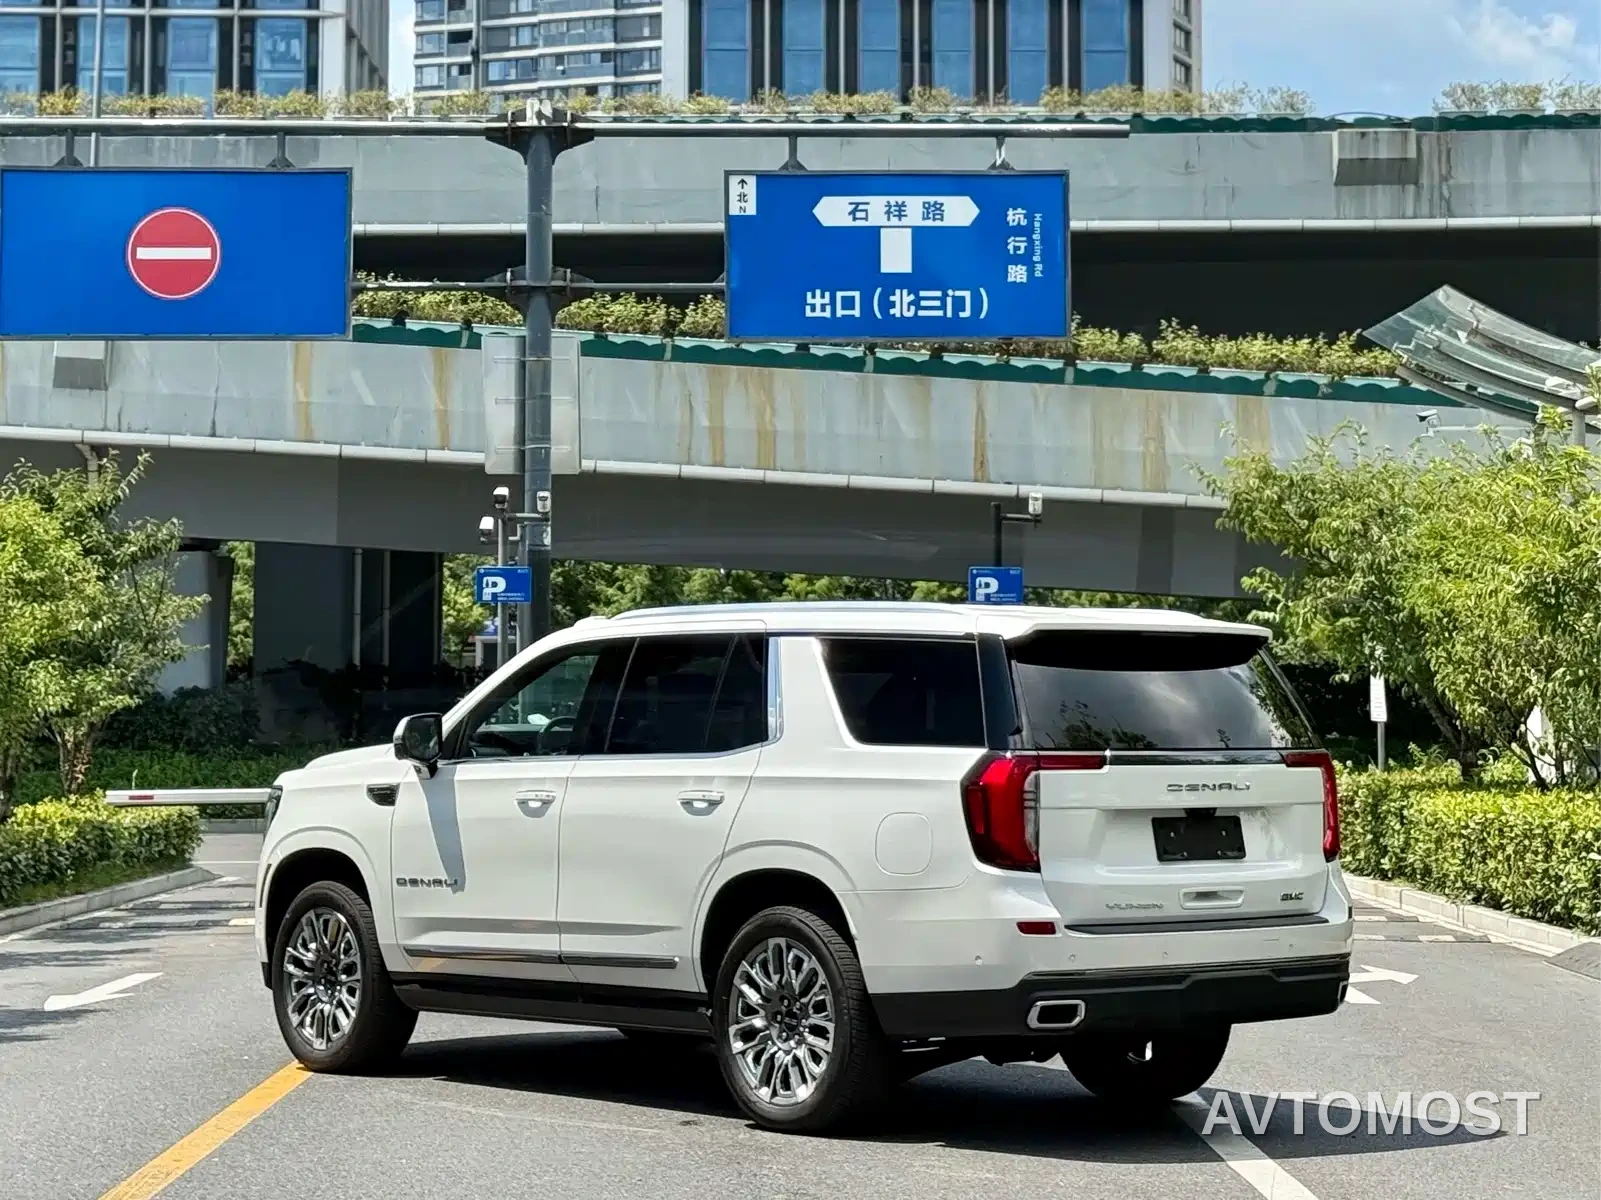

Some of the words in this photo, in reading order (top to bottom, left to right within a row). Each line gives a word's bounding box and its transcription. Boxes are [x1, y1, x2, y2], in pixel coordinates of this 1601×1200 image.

[737, 191, 749, 204] 北
[739, 205, 747, 214] N
[848, 200, 946, 222] 石祥路
[1032, 213, 1043, 262] Hangxing
[1006, 207, 1028, 283] 杭行路
[1034, 263, 1043, 277] Rd
[1166, 782, 1251, 792] DENALI
[396, 877, 459, 888] DENALI
